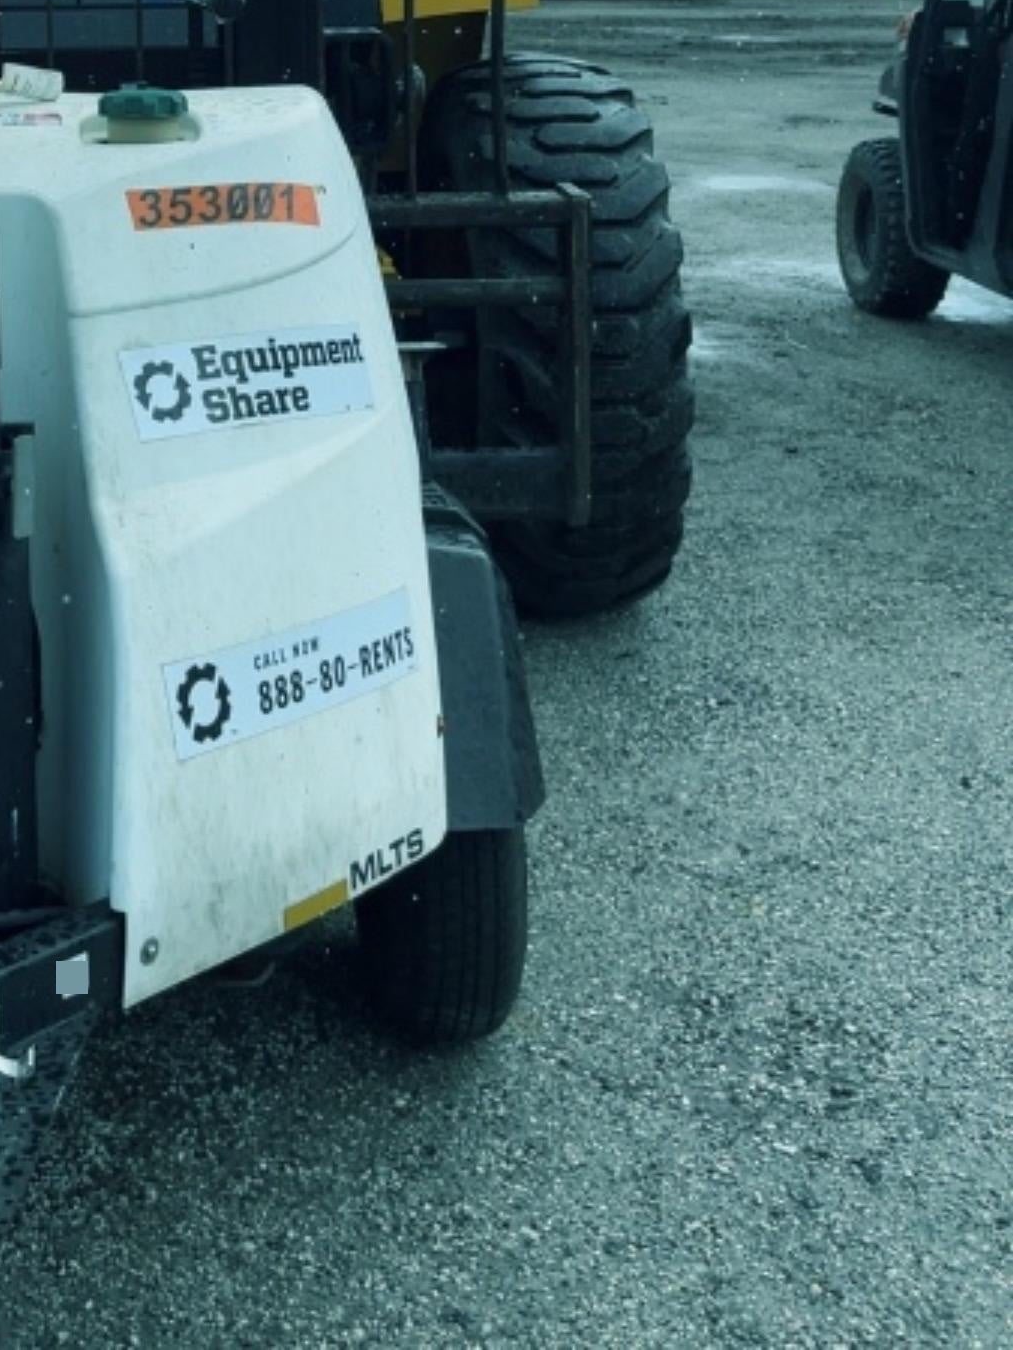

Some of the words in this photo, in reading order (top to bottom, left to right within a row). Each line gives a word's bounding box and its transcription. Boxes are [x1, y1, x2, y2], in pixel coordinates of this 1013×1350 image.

[138, 184, 298, 227] 353001
[190, 332, 365, 383] Equipment
[201, 383, 310, 424] Share
[254, 648, 287, 670] CALL
[258, 626, 414, 714] 888-80-RENTS
[349, 828, 424, 890] MLTS
